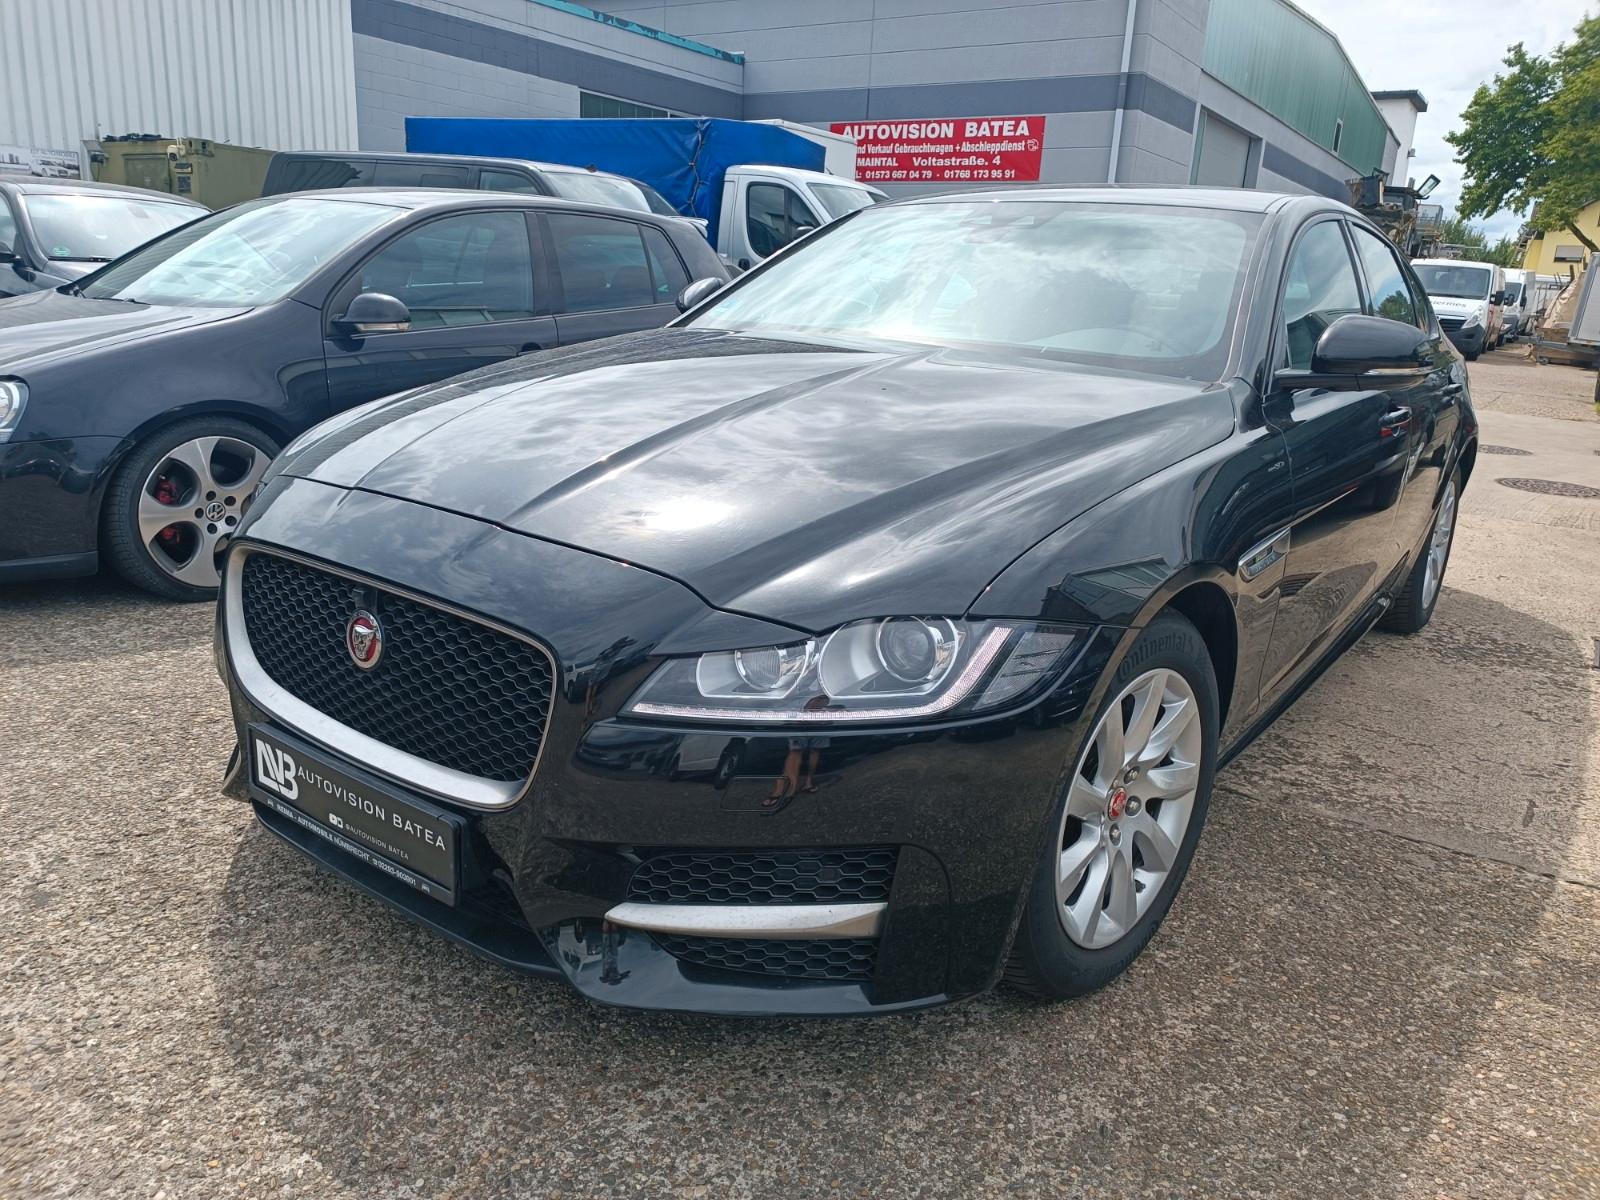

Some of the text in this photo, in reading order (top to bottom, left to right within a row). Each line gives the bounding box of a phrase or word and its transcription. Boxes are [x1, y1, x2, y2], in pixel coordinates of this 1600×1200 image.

[842, 120, 1030, 140] AUTOVISION BATEA
[867, 143, 893, 154] Verkauf
[894, 141, 953, 156] Gebrauchtwagen
[960, 139, 1025, 155] Abschleppdienst
[856, 157, 899, 167] MAINTAL
[991, 154, 1001, 166] 4
[865, 170, 890, 179] 01573
[908, 170, 920, 179] 04
[921, 170, 933, 179] 79
[944, 169, 971, 179] 01768
[973, 169, 990, 178] 173
[991, 169, 1003, 178] 95
[1004, 169, 1016, 178] 91
[297, 766, 446, 851] AUTOVISION BATEA
[388, 844, 409, 860] BATEA
